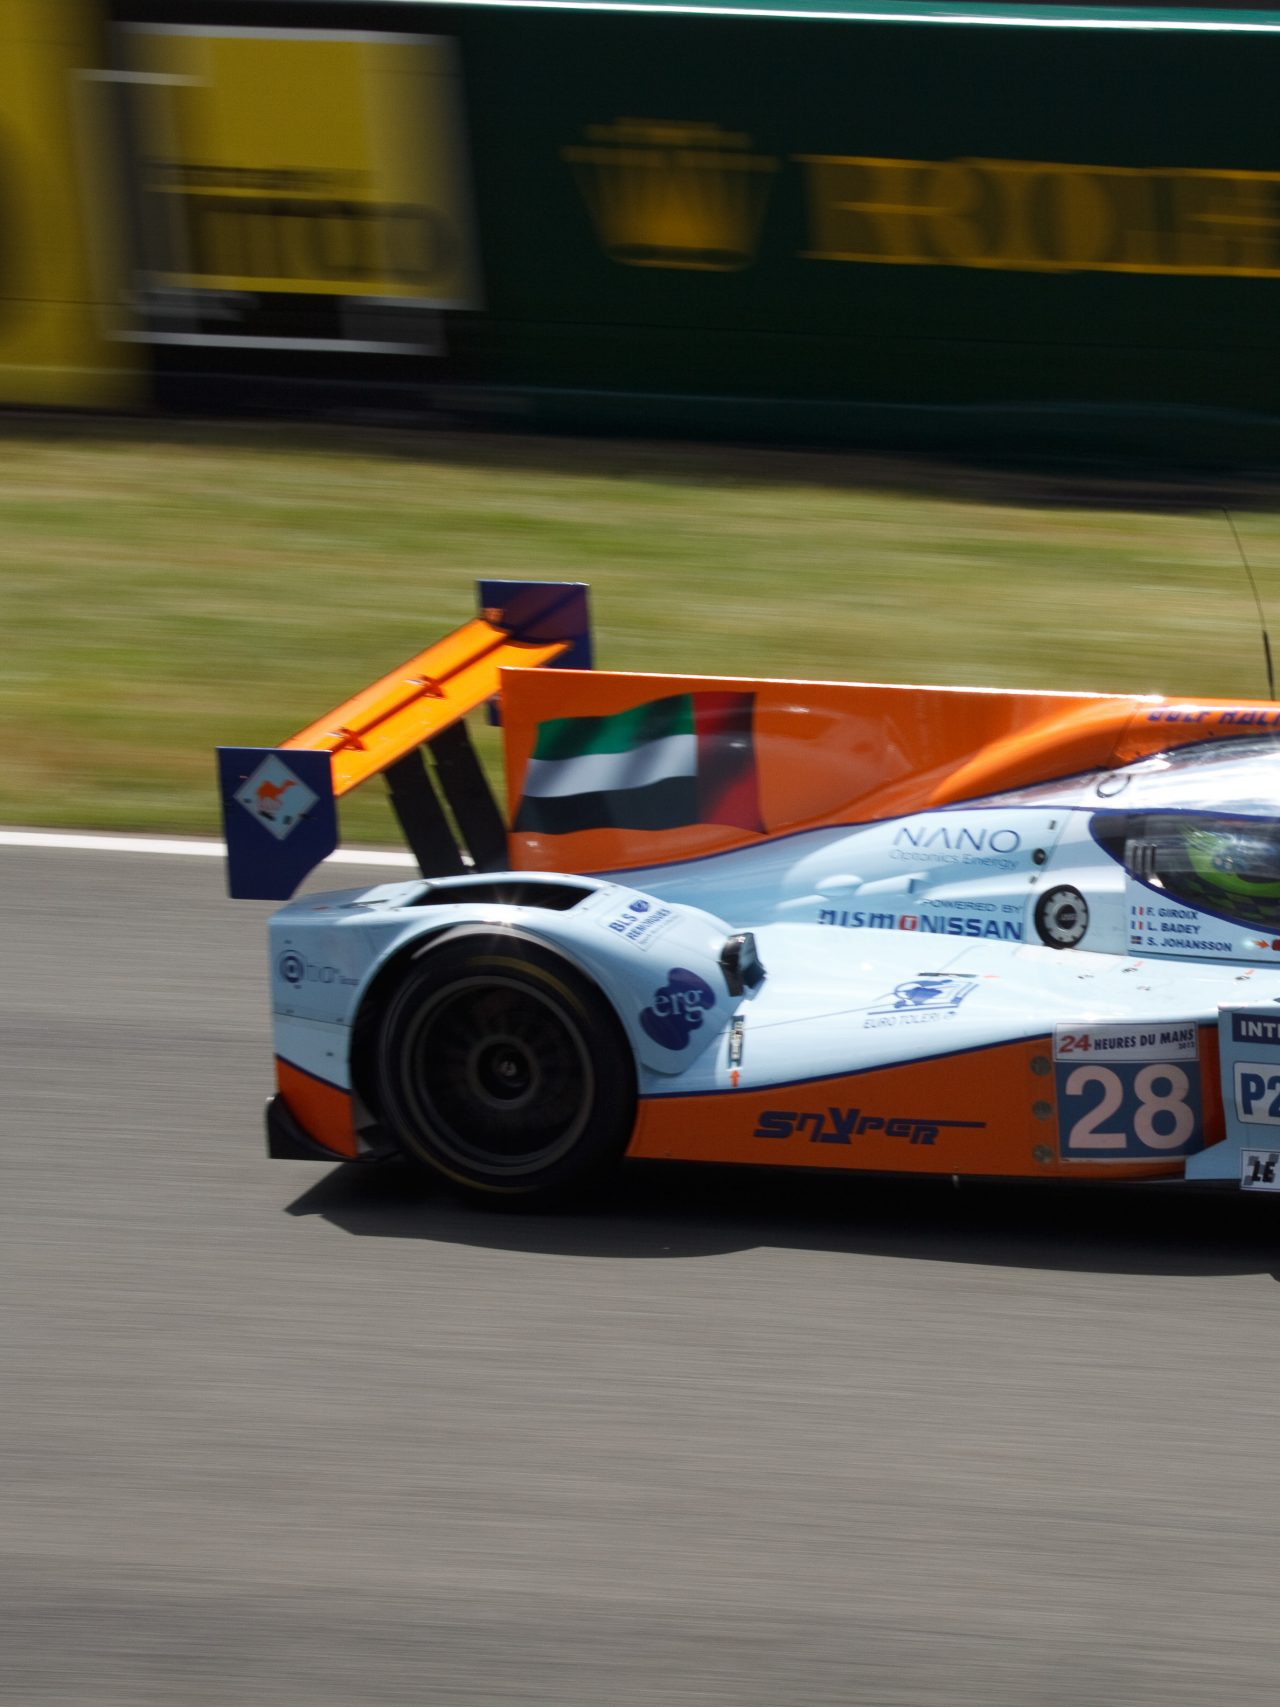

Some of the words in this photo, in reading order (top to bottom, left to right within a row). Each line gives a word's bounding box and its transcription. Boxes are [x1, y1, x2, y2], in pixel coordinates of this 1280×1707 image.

[893, 827, 1021, 853] NANO
[963, 854, 1020, 870] Energy
[1002, 903, 1023, 914] BY
[1158, 907, 1199, 920] GIROIX
[608, 913, 638, 933] BLS
[919, 914, 1025, 941] NISSAN
[1161, 922, 1200, 935] BADEY
[1161, 937, 1233, 952] JOHANSSON
[652, 990, 703, 1022] erg
[1059, 1034, 1092, 1053] 24
[1094, 1036, 1137, 1051] HEURES
[1140, 1034, 1156, 1046] DU
[1160, 1029, 1194, 1045] MANS
[1065, 1063, 1195, 1149] 28
[1251, 1160, 1276, 1183] LE
